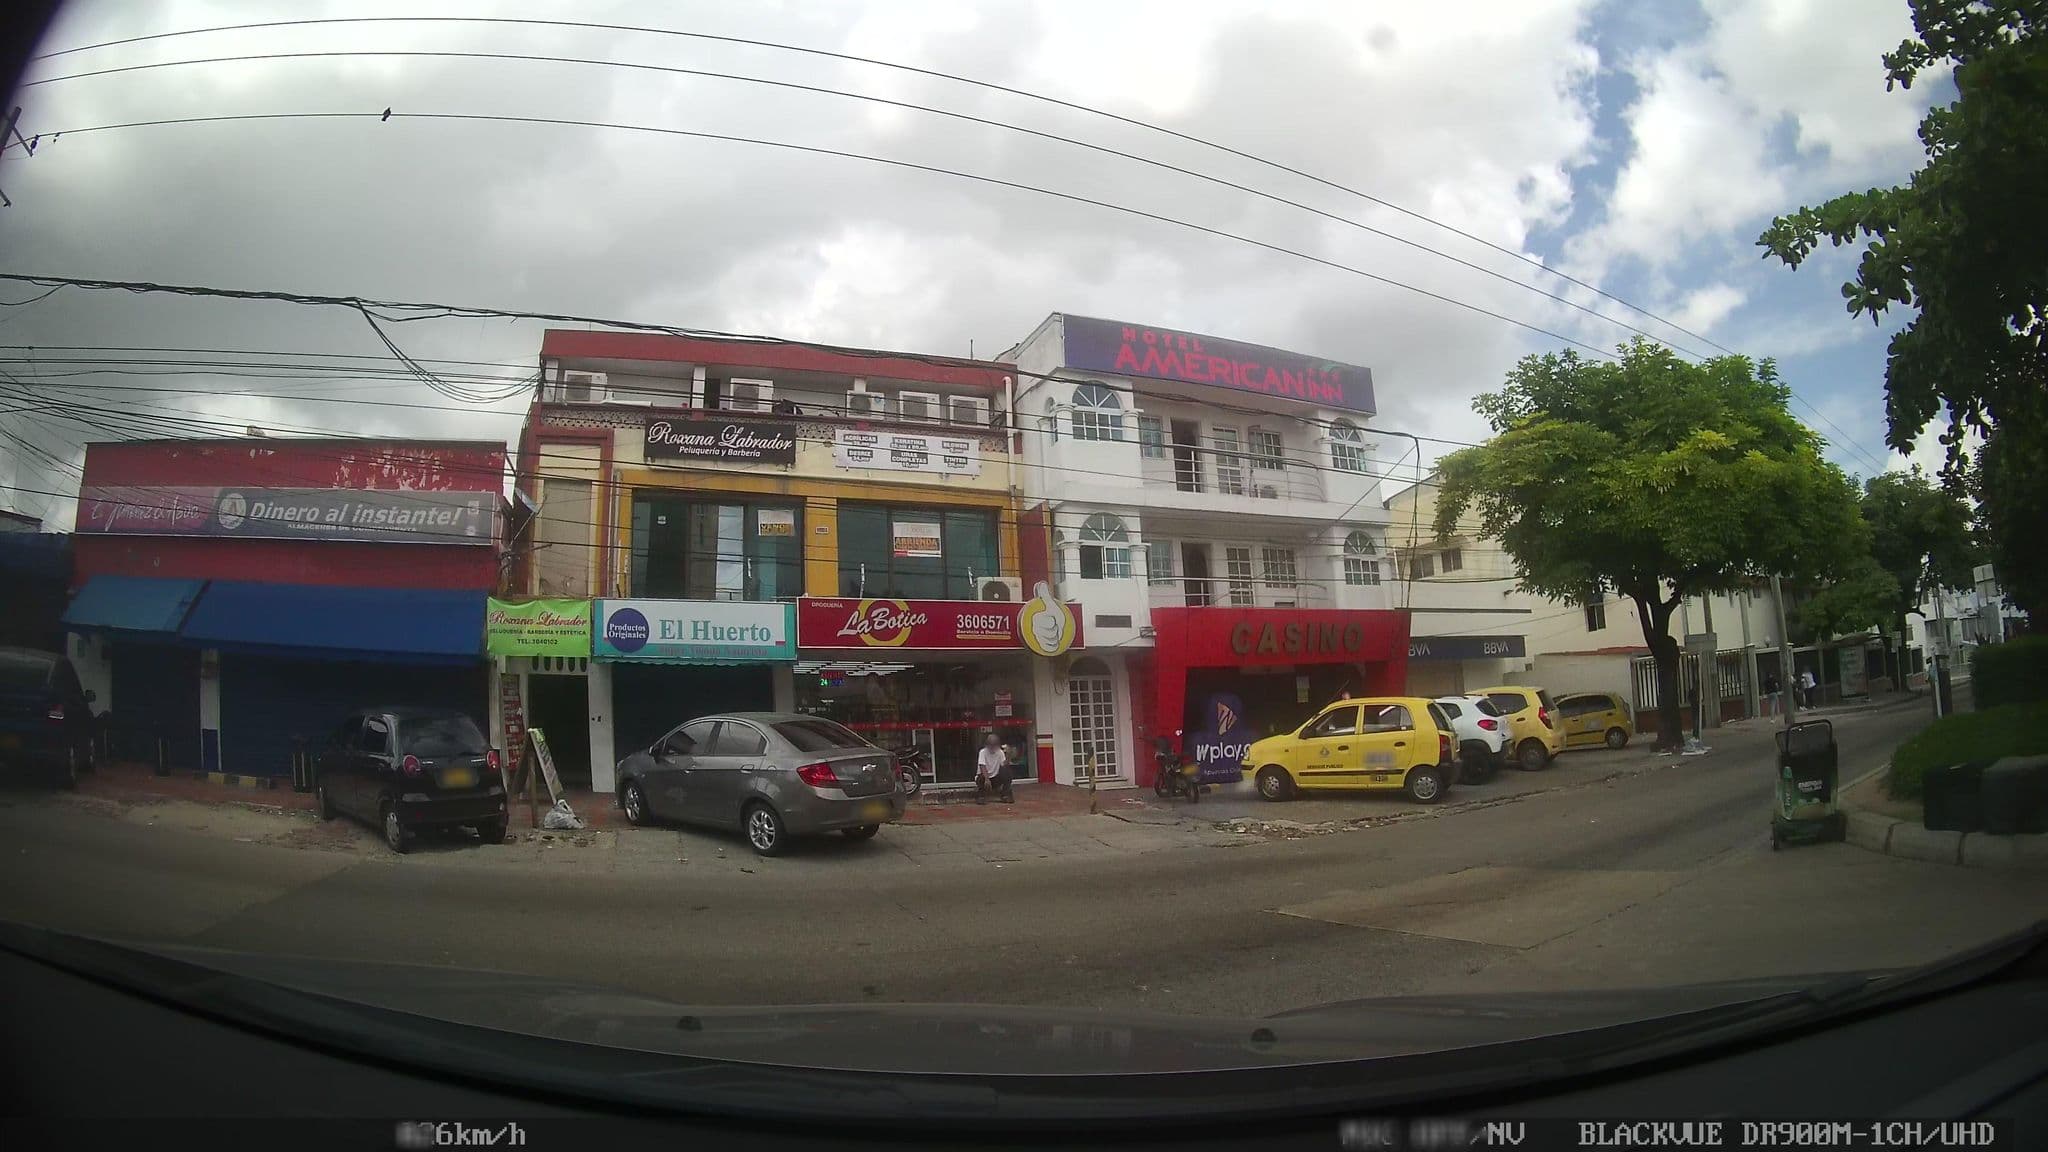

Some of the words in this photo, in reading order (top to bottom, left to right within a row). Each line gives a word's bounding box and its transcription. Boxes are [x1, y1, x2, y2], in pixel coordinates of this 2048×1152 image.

[1120, 326, 1206, 352] HOTEL
[1114, 344, 1305, 398] AMERICAN
[1308, 377, 1344, 400] INN
[648, 422, 715, 445] Roxana
[718, 425, 793, 450] Labrador
[679, 446, 720, 456] Peluquería
[721, 448, 727, 457] y
[727, 448, 761, 457] Barbería
[251, 501, 320, 522] Dinero
[325, 503, 350, 523] al
[352, 503, 466, 526] instante!
[489, 610, 534, 626] Roxana
[536, 610, 588, 627] Labrador
[609, 623, 647, 633] Productos
[871, 606, 928, 631] Botica
[956, 614, 1010, 631] 3606571
[608, 631, 647, 640] Originales
[659, 619, 684, 640] El
[691, 620, 772, 642] Huerto
[1231, 621, 1364, 656] CASINO
[1483, 640, 1510, 655] BBVA
